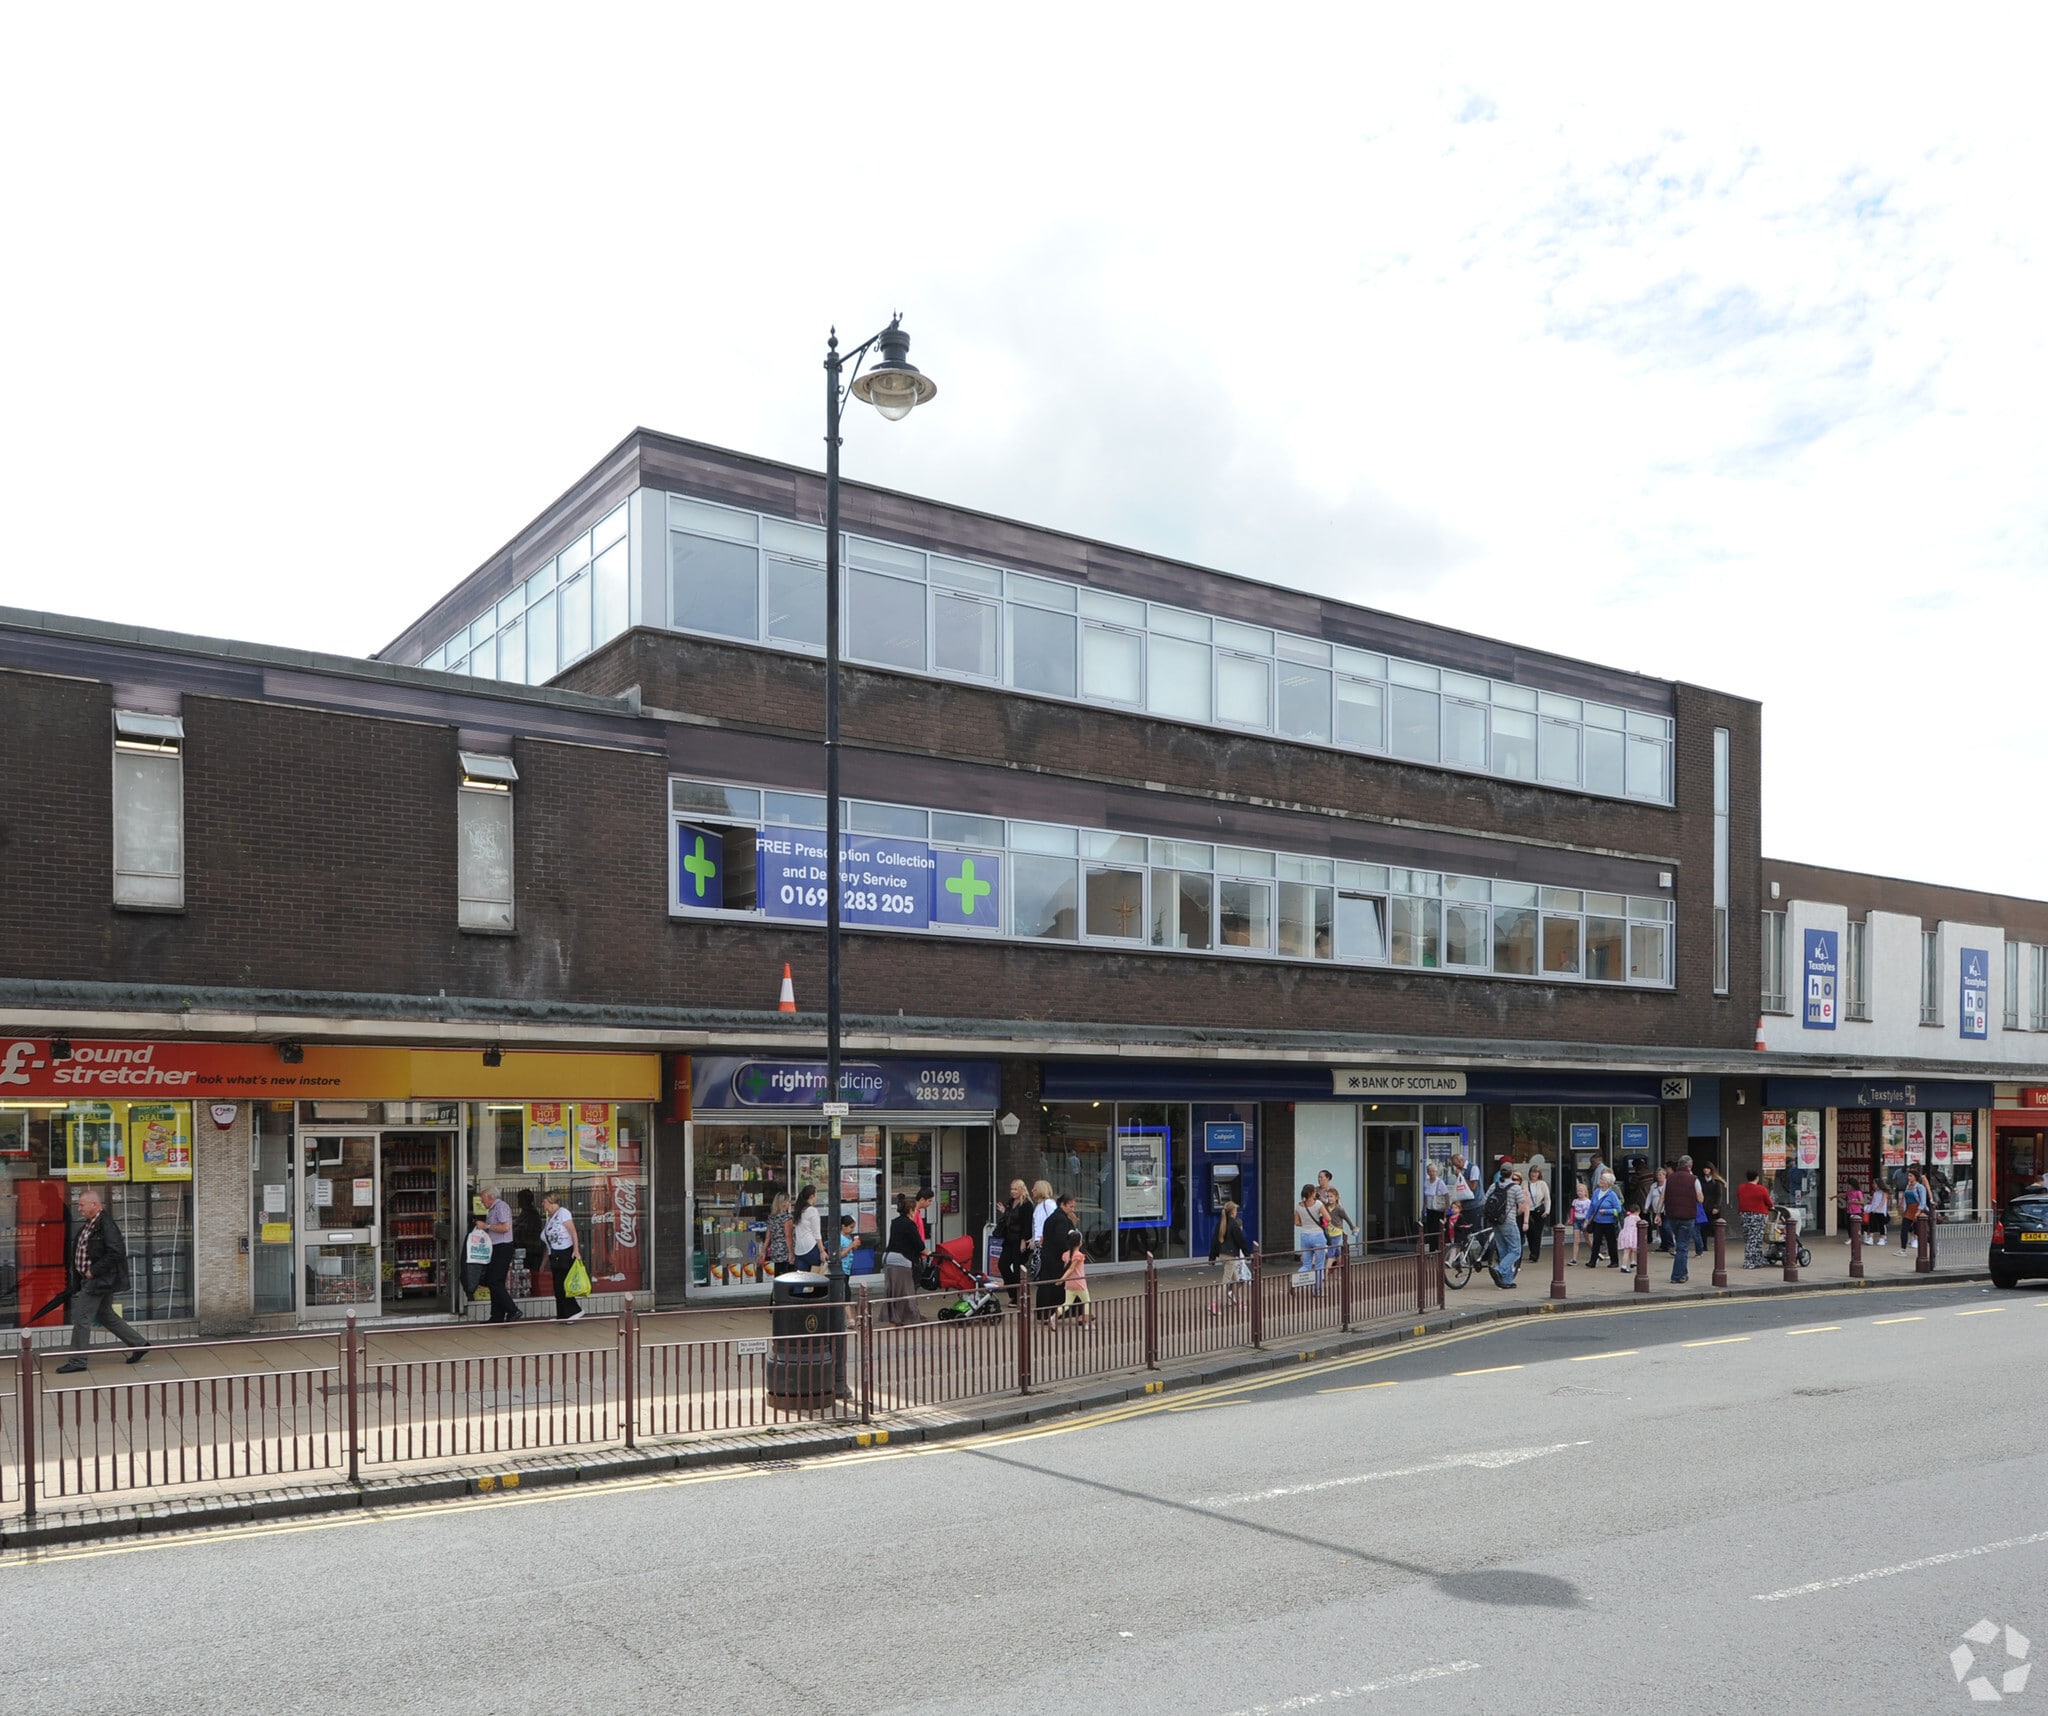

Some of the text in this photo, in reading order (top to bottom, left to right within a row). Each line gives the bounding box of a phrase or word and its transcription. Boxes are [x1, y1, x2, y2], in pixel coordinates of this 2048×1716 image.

[756, 838, 791, 855] FREE
[877, 851, 935, 869] Collection
[783, 867, 806, 879] and
[863, 872, 907, 888] Service
[781, 885, 914, 914] 0169 283 205
[1808, 960, 1836, 973] Texstyles
[1964, 976, 1987, 988] Texstyles
[53, 1066, 196, 1085] stretcher
[196, 1075, 223, 1084] look
[227, 1076, 267, 1085] what's
[300, 1076, 340, 1085] instore
[771, 1070, 883, 1092] rightmdicine
[921, 1071, 959, 1084] 01698
[1362, 1077, 1457, 1089] BANK OF SCOTLAND
[916, 1087, 965, 1101] 283 205
[1870, 1089, 1904, 1103] Texstyles
[536, 1110, 555, 1118] HOT
[585, 1110, 603, 1118] HOT
[1838, 1113, 1870, 1121] MASSIVE
[1839, 1133, 1871, 1141] CUSHION
[1838, 1142, 1871, 1158] SALE
[1838, 1164, 1869, 1172] MASSIVE
